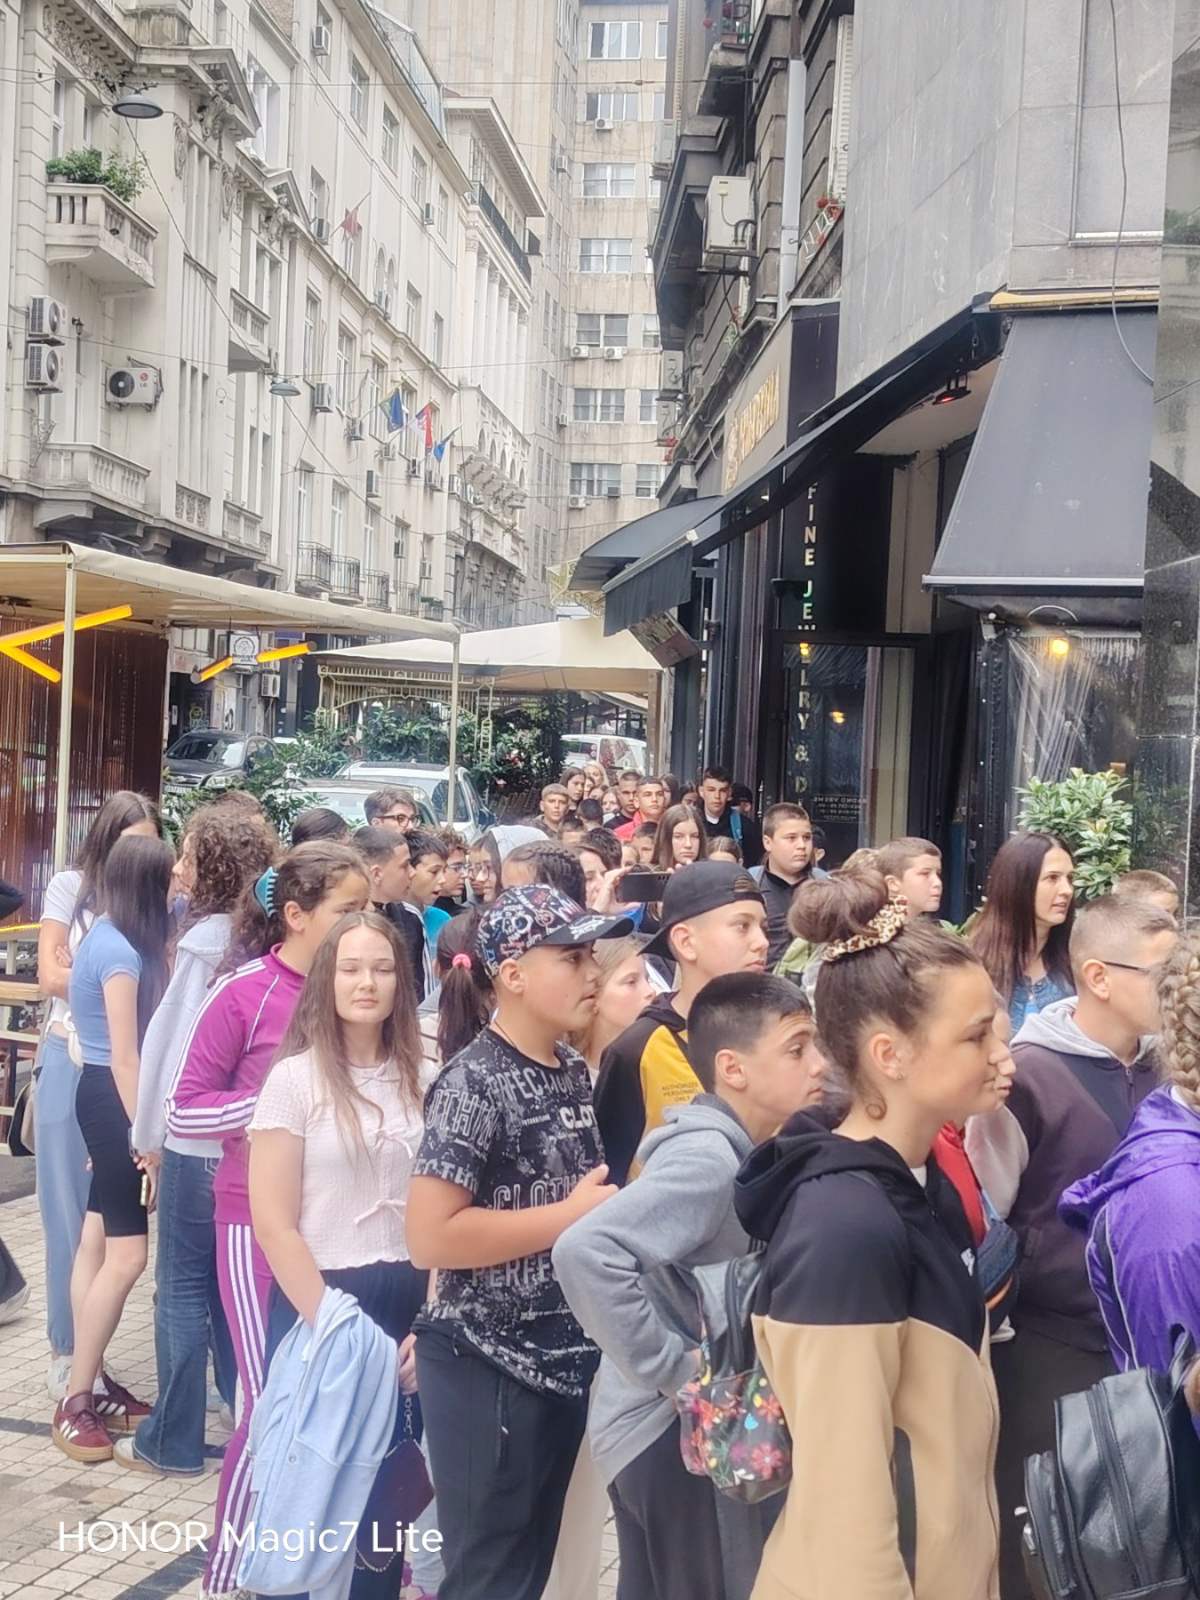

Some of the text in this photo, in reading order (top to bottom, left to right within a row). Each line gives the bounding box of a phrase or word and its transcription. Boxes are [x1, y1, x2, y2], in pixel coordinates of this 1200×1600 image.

[804, 482, 818, 566] FINE
[798, 580, 817, 730] JELRY
[795, 745, 809, 762] &
